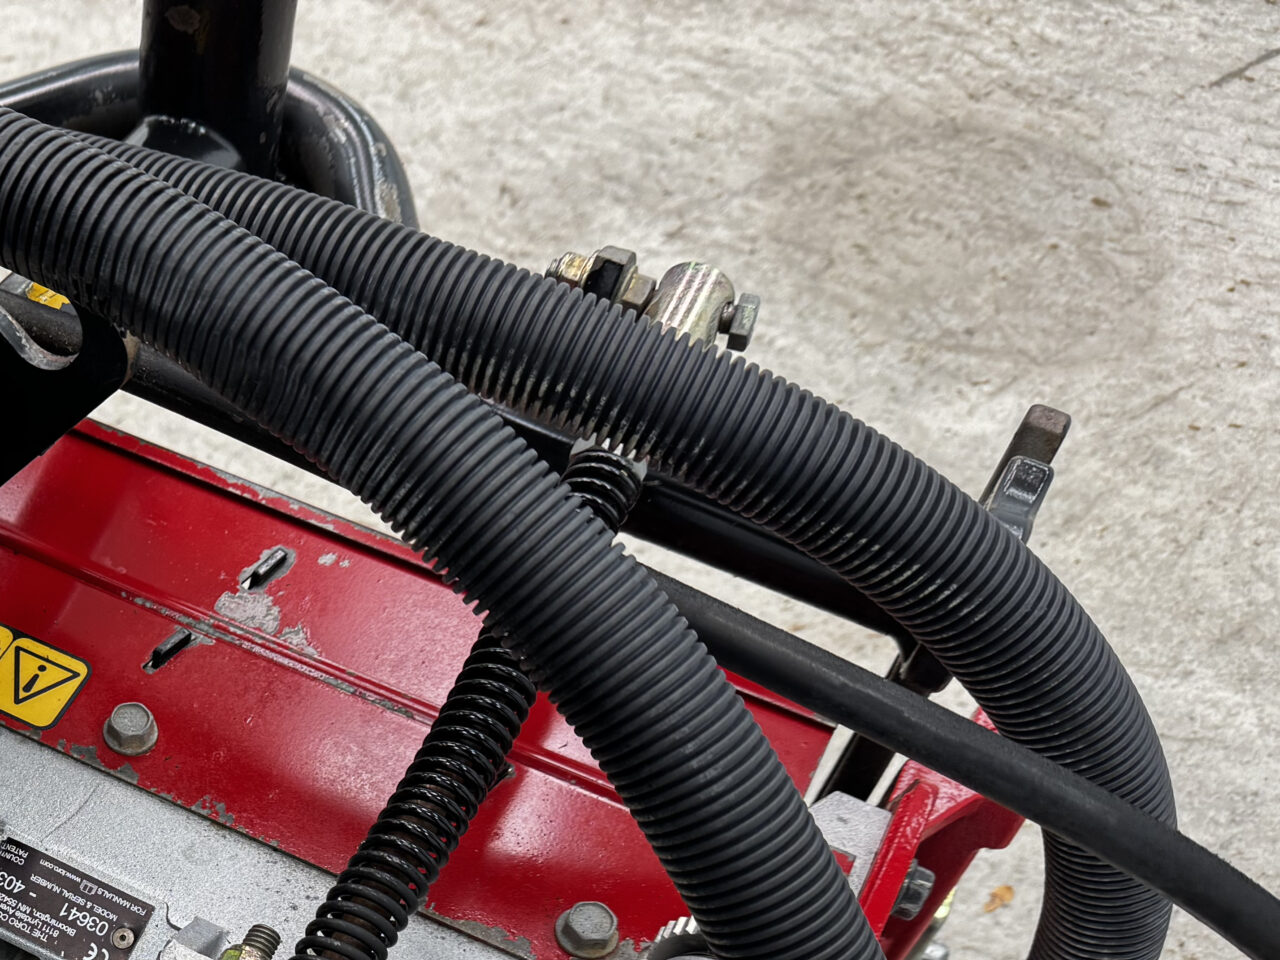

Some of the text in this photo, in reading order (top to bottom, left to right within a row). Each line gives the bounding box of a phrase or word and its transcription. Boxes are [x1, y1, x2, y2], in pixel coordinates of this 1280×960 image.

[39, 858, 81, 882] www.toro.com
[30, 873, 61, 893] NUMBER
[61, 888, 86, 905] SERIAL
[96, 887, 146, 915] FOR MANUALS
[16, 902, 31, 913] MN
[92, 903, 118, 921] MODEL
[8, 917, 31, 933] TORO
[14, 910, 42, 928] Lyndale
[30, 908, 76, 936] Bloomington,
[59, 902, 108, 936] 03641
[30, 928, 48, 942] THE
[41, 924, 59, 937] 8111
